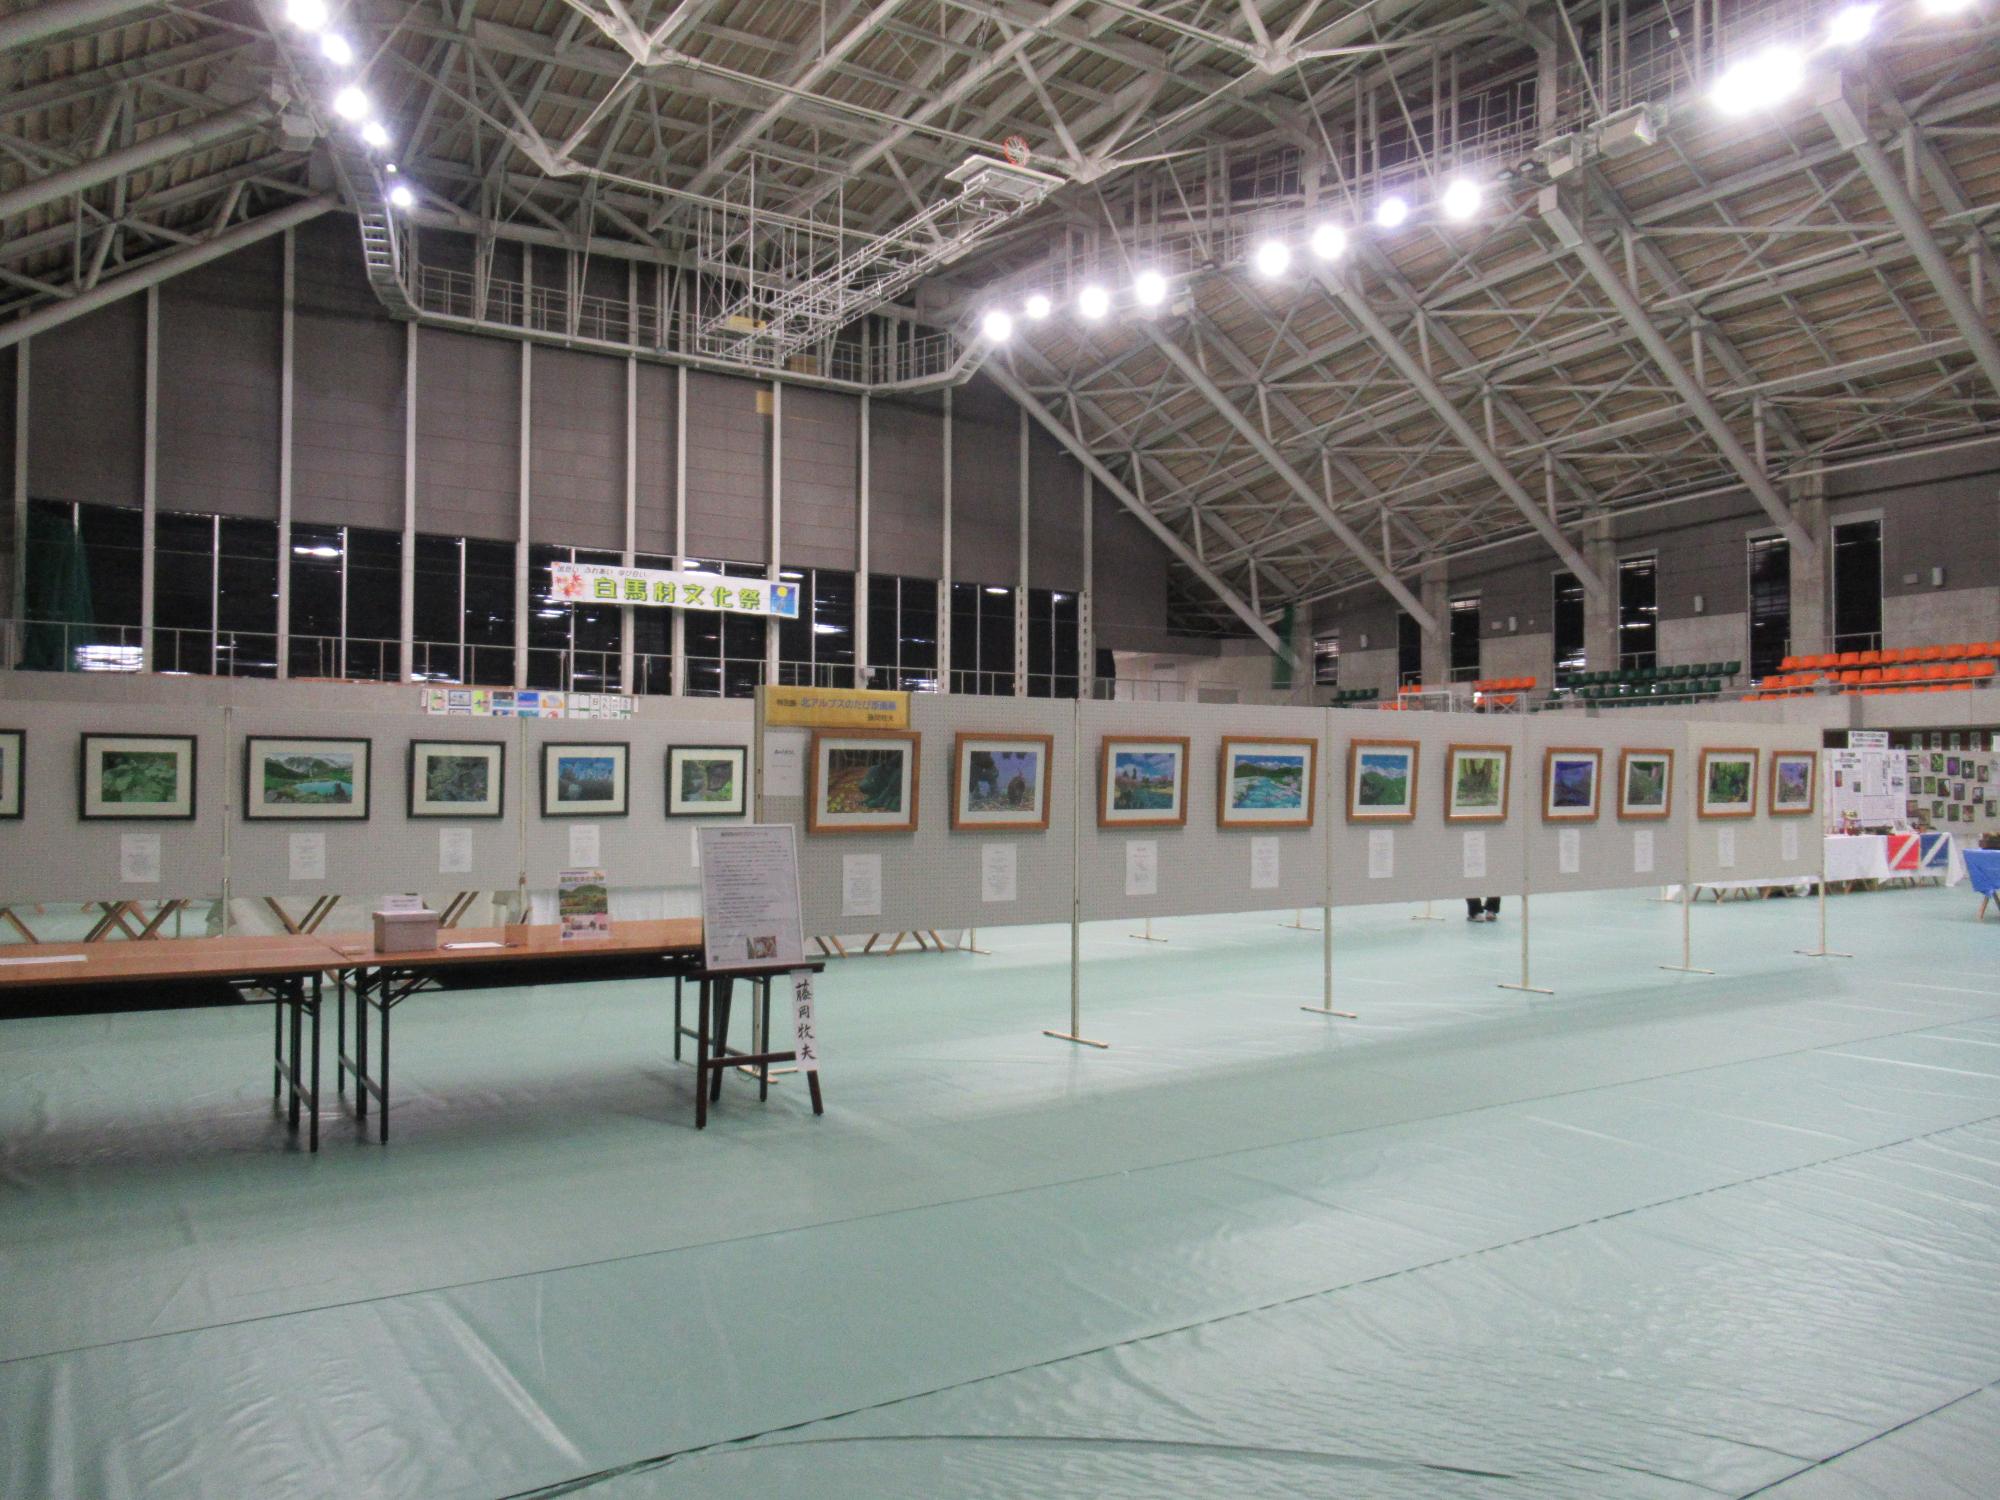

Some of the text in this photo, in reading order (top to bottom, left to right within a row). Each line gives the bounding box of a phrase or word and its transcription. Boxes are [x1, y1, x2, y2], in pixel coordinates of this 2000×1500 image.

[593, 578, 761, 610] 白馬村文化祭
[796, 978, 816, 1061] 藤岡牧夫
